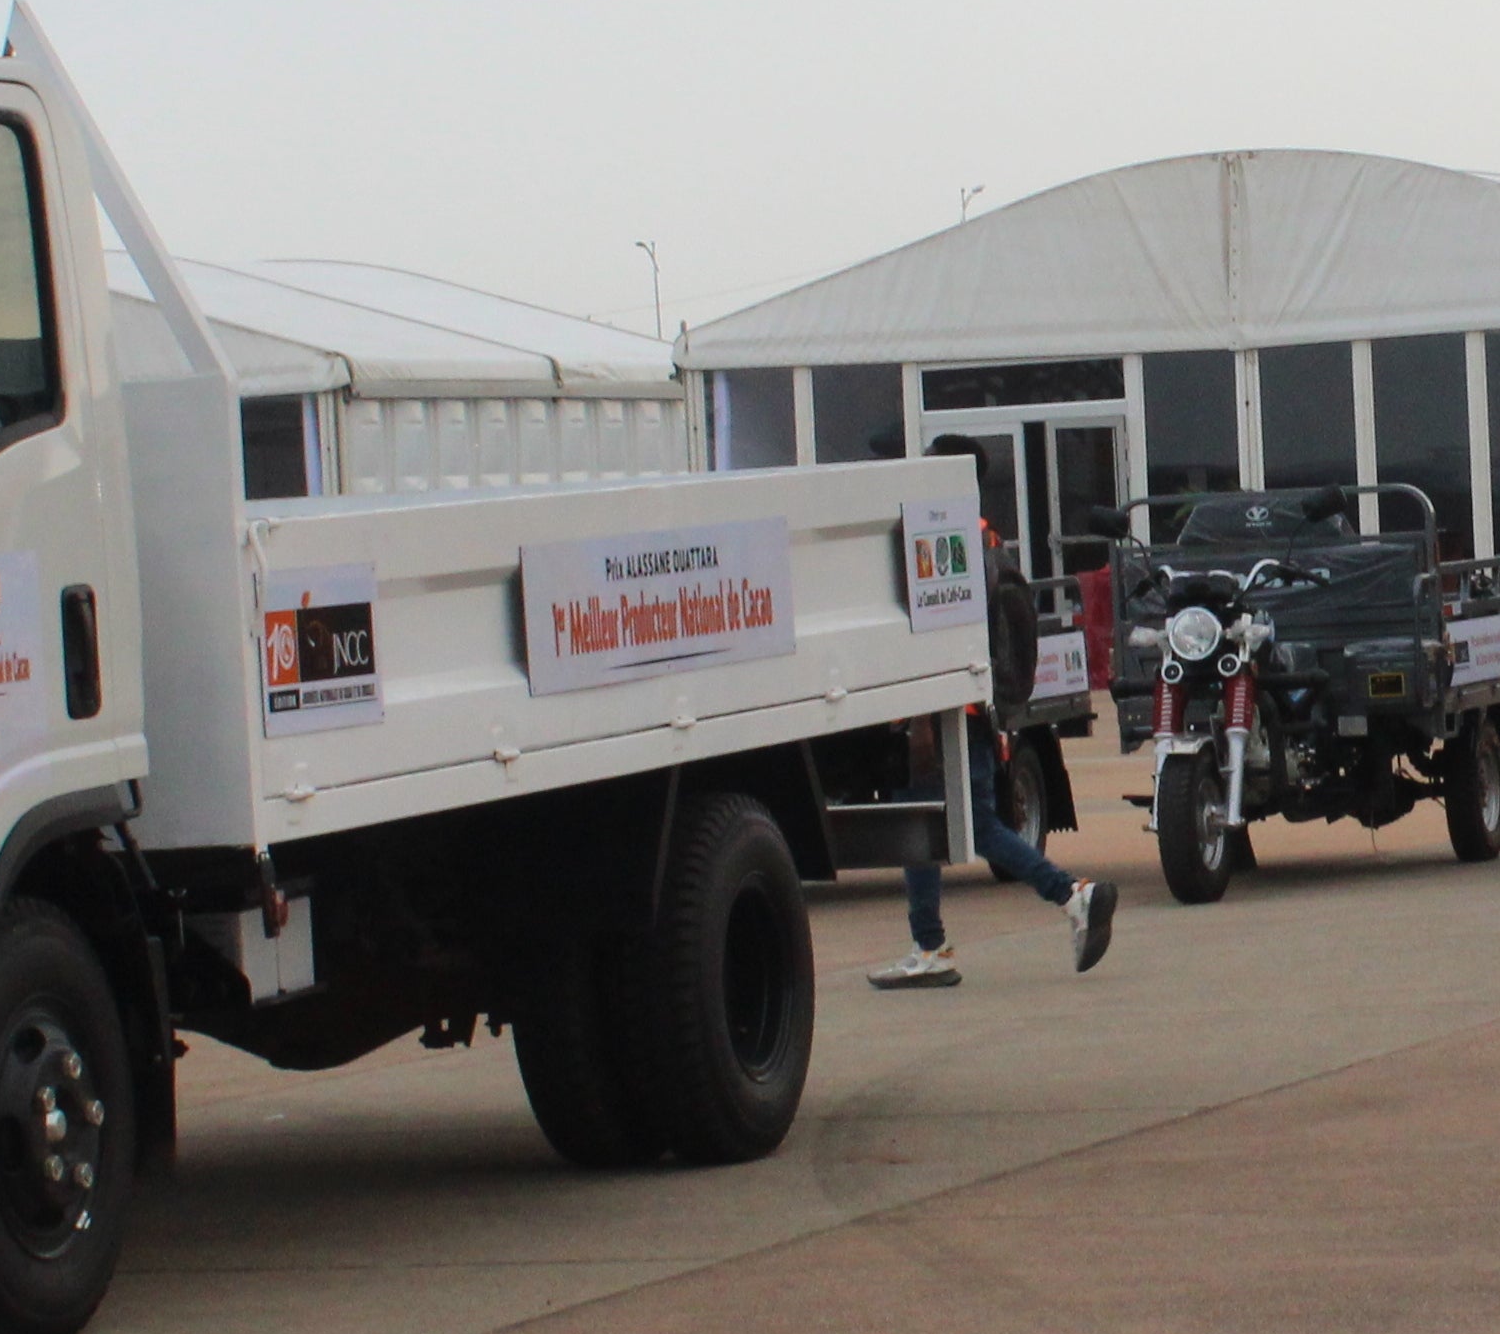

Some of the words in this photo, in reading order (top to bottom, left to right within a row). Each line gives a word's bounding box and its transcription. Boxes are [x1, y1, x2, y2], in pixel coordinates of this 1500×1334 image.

[605, 555, 623, 581] Prix
[626, 551, 671, 579] ALASSANE
[673, 546, 719, 573] OUATTARA
[570, 596, 619, 655] Meilleur
[620, 591, 677, 647] Producteur
[679, 579, 726, 637] National
[727, 578, 740, 631] de
[742, 577, 773, 629] Cacao
[333, 630, 369, 674] JNCC
